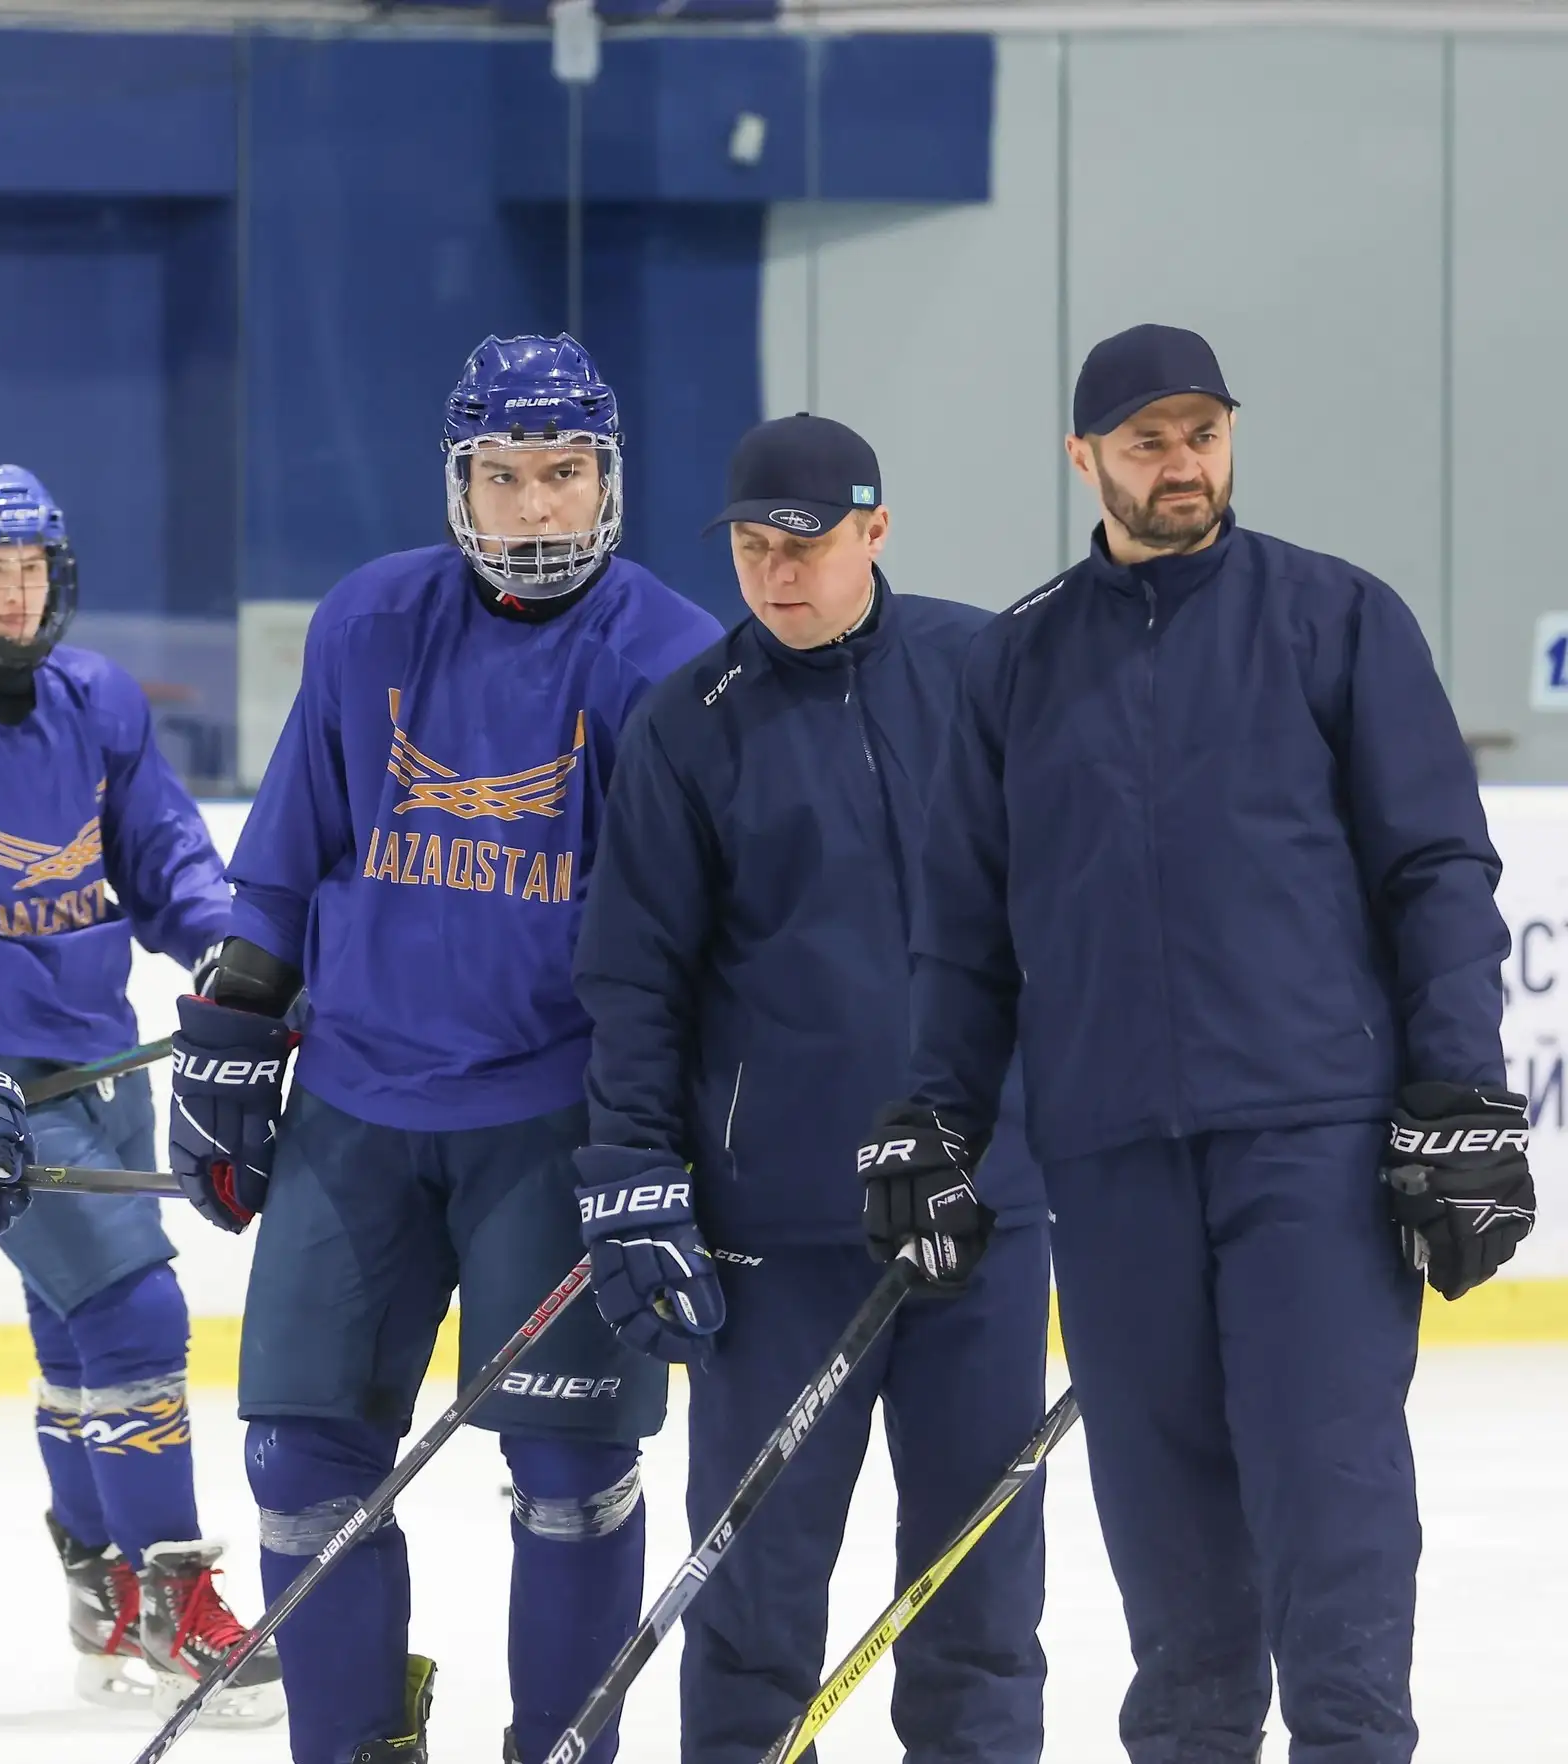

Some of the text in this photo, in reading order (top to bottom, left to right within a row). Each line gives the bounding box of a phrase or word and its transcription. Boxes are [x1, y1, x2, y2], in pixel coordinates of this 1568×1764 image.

[505, 397, 561, 408] BAUER
[703, 664, 742, 706] CCM
[173, 1048, 280, 1085] AUER
[580, 1183, 691, 1223] AUER
[714, 1248, 764, 1267] CCM
[493, 1371, 621, 1399] AUER
[316, 1507, 368, 1565] BAUER
[713, 1520, 733, 1550] T10
[811, 1626, 895, 1730] SUPREME
